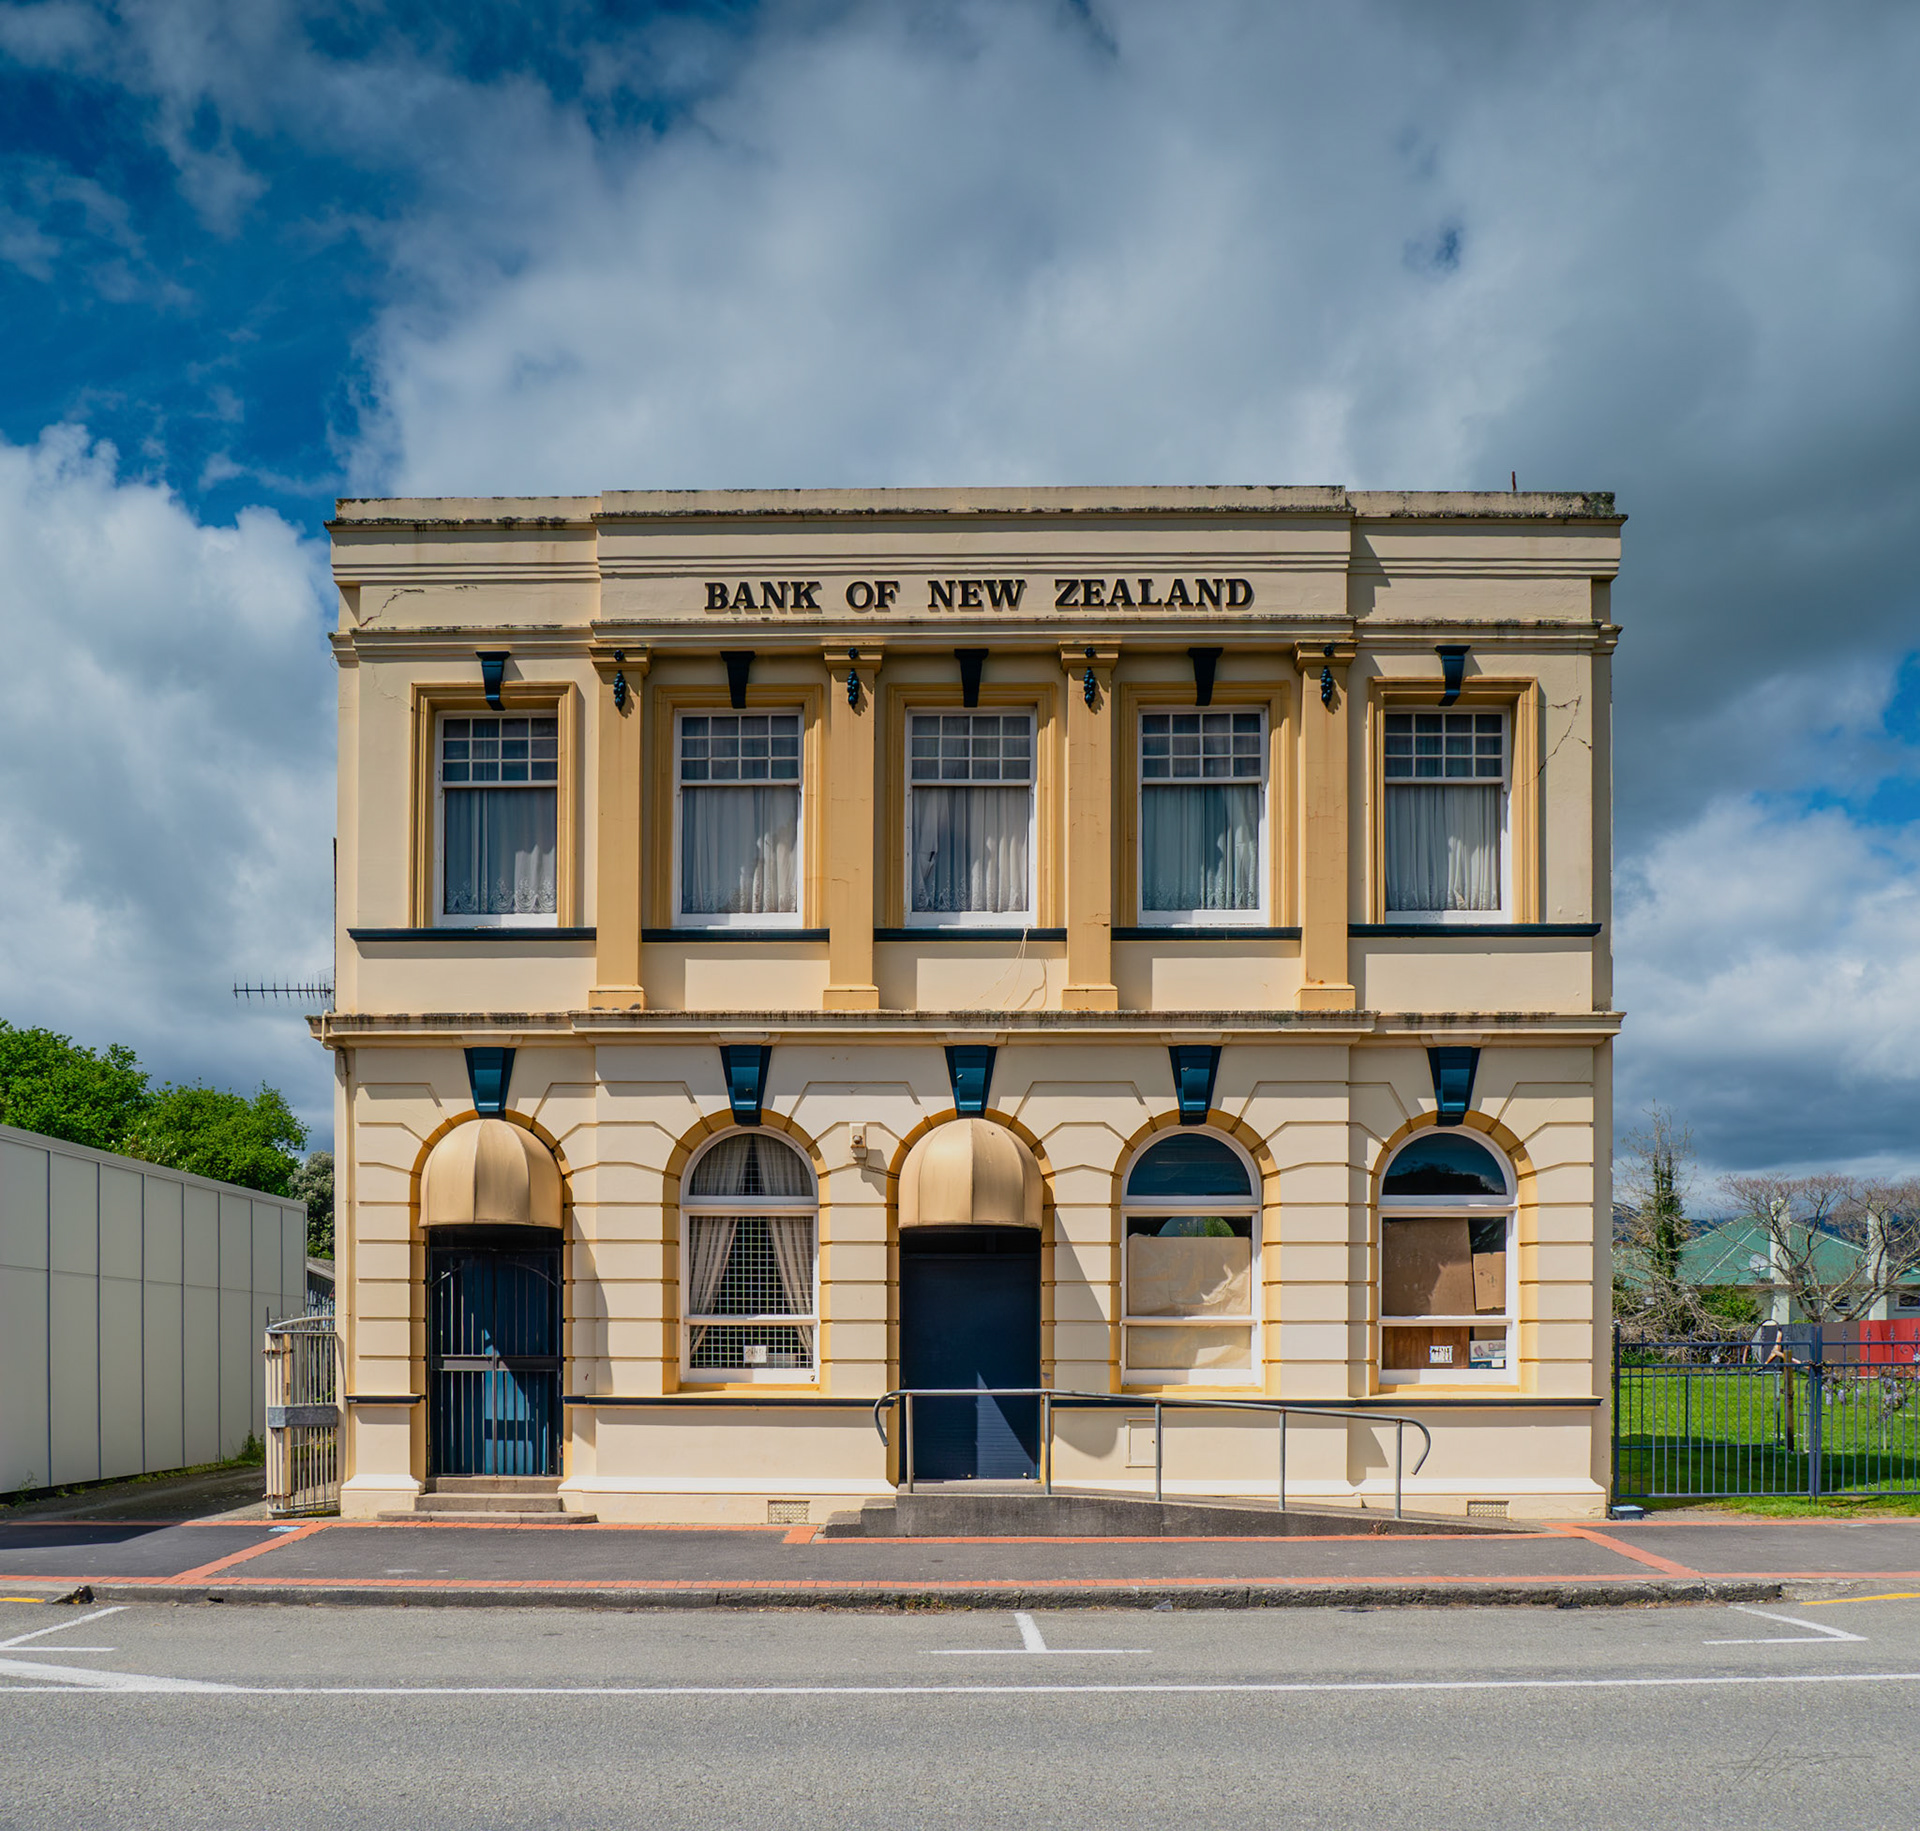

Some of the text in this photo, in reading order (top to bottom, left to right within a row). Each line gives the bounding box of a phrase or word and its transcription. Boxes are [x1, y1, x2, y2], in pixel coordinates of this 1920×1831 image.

[704, 578, 1254, 611] BANK OF NEW ZEALAND
